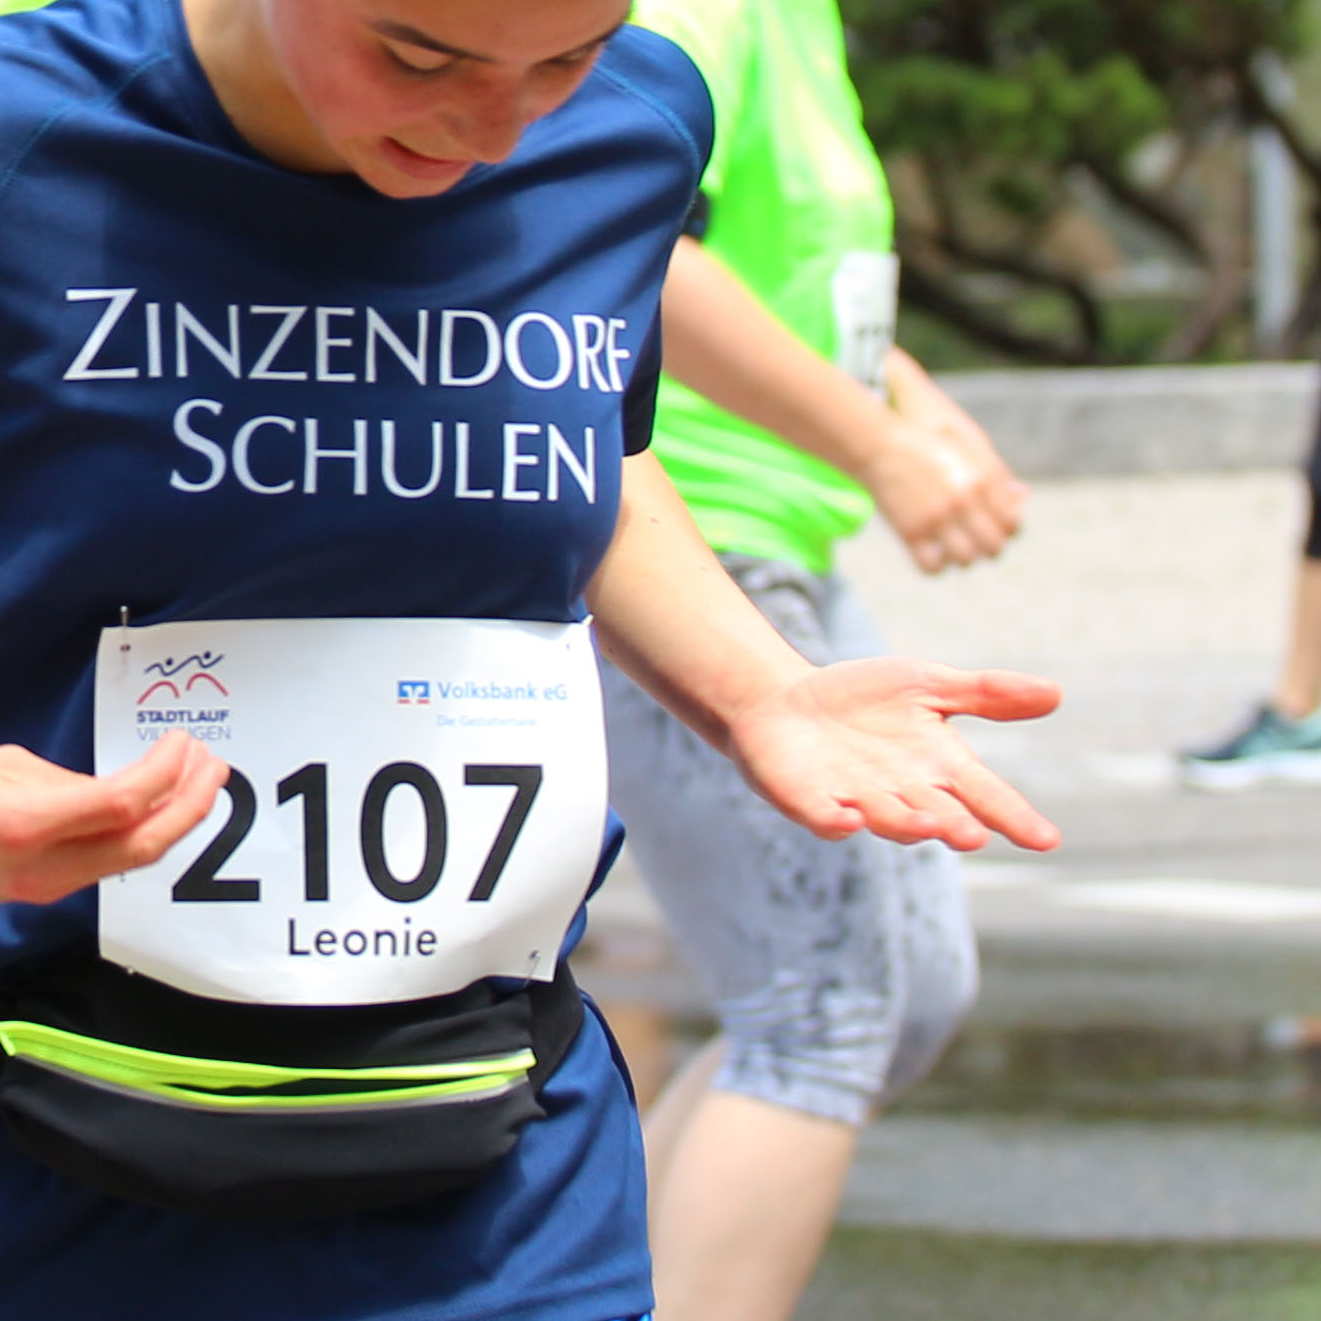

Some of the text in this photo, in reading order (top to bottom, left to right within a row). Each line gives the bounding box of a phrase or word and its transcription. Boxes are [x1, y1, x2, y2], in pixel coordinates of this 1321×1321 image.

[63, 287, 631, 393] ZINZENDORF
[169, 398, 597, 505] SCHULEN
[137, 709, 230, 723] STADTLAUF
[437, 676, 569, 700] Volksbank eG
[171, 761, 544, 903] 2107
[287, 917, 438, 957] Leonie
